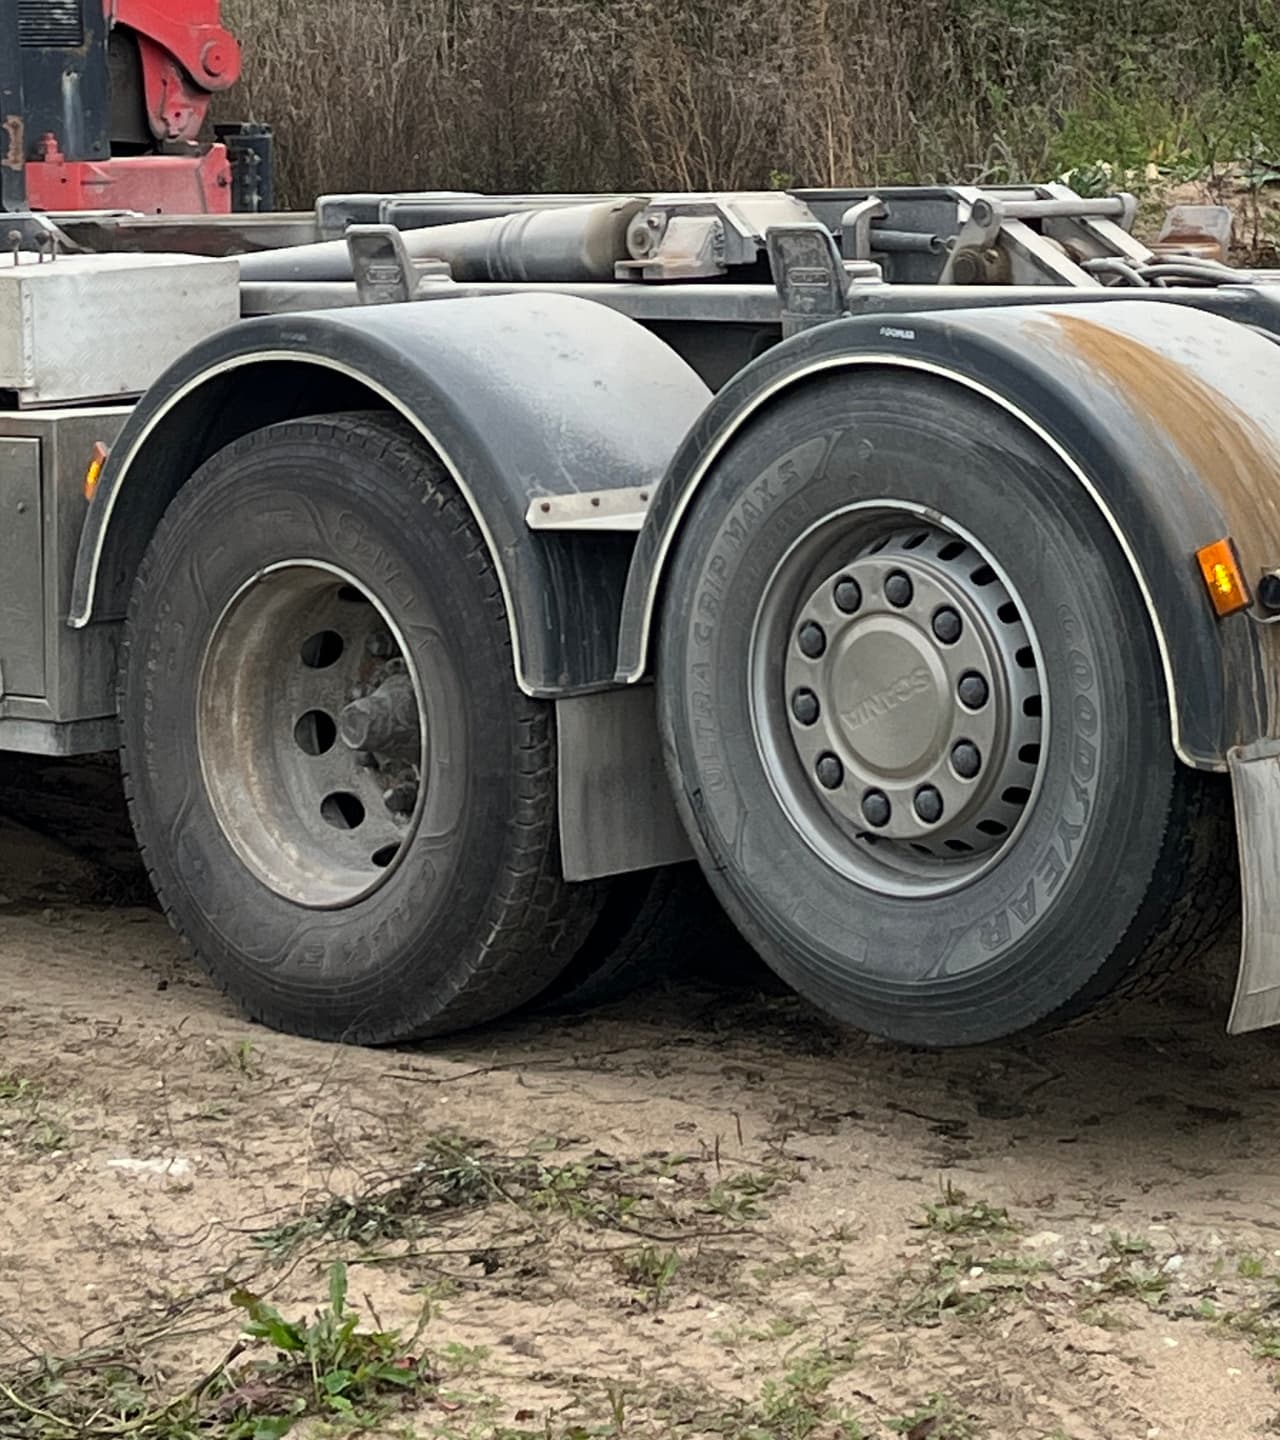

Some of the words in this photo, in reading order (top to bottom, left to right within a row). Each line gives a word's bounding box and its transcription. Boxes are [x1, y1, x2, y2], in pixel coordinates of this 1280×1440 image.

[693, 554, 726, 651] GRIP
[722, 479, 779, 548] MAX
[777, 458, 800, 491] S
[840, 666, 930, 730] SCANIA
[979, 604, 1098, 951] GOODYEAR
